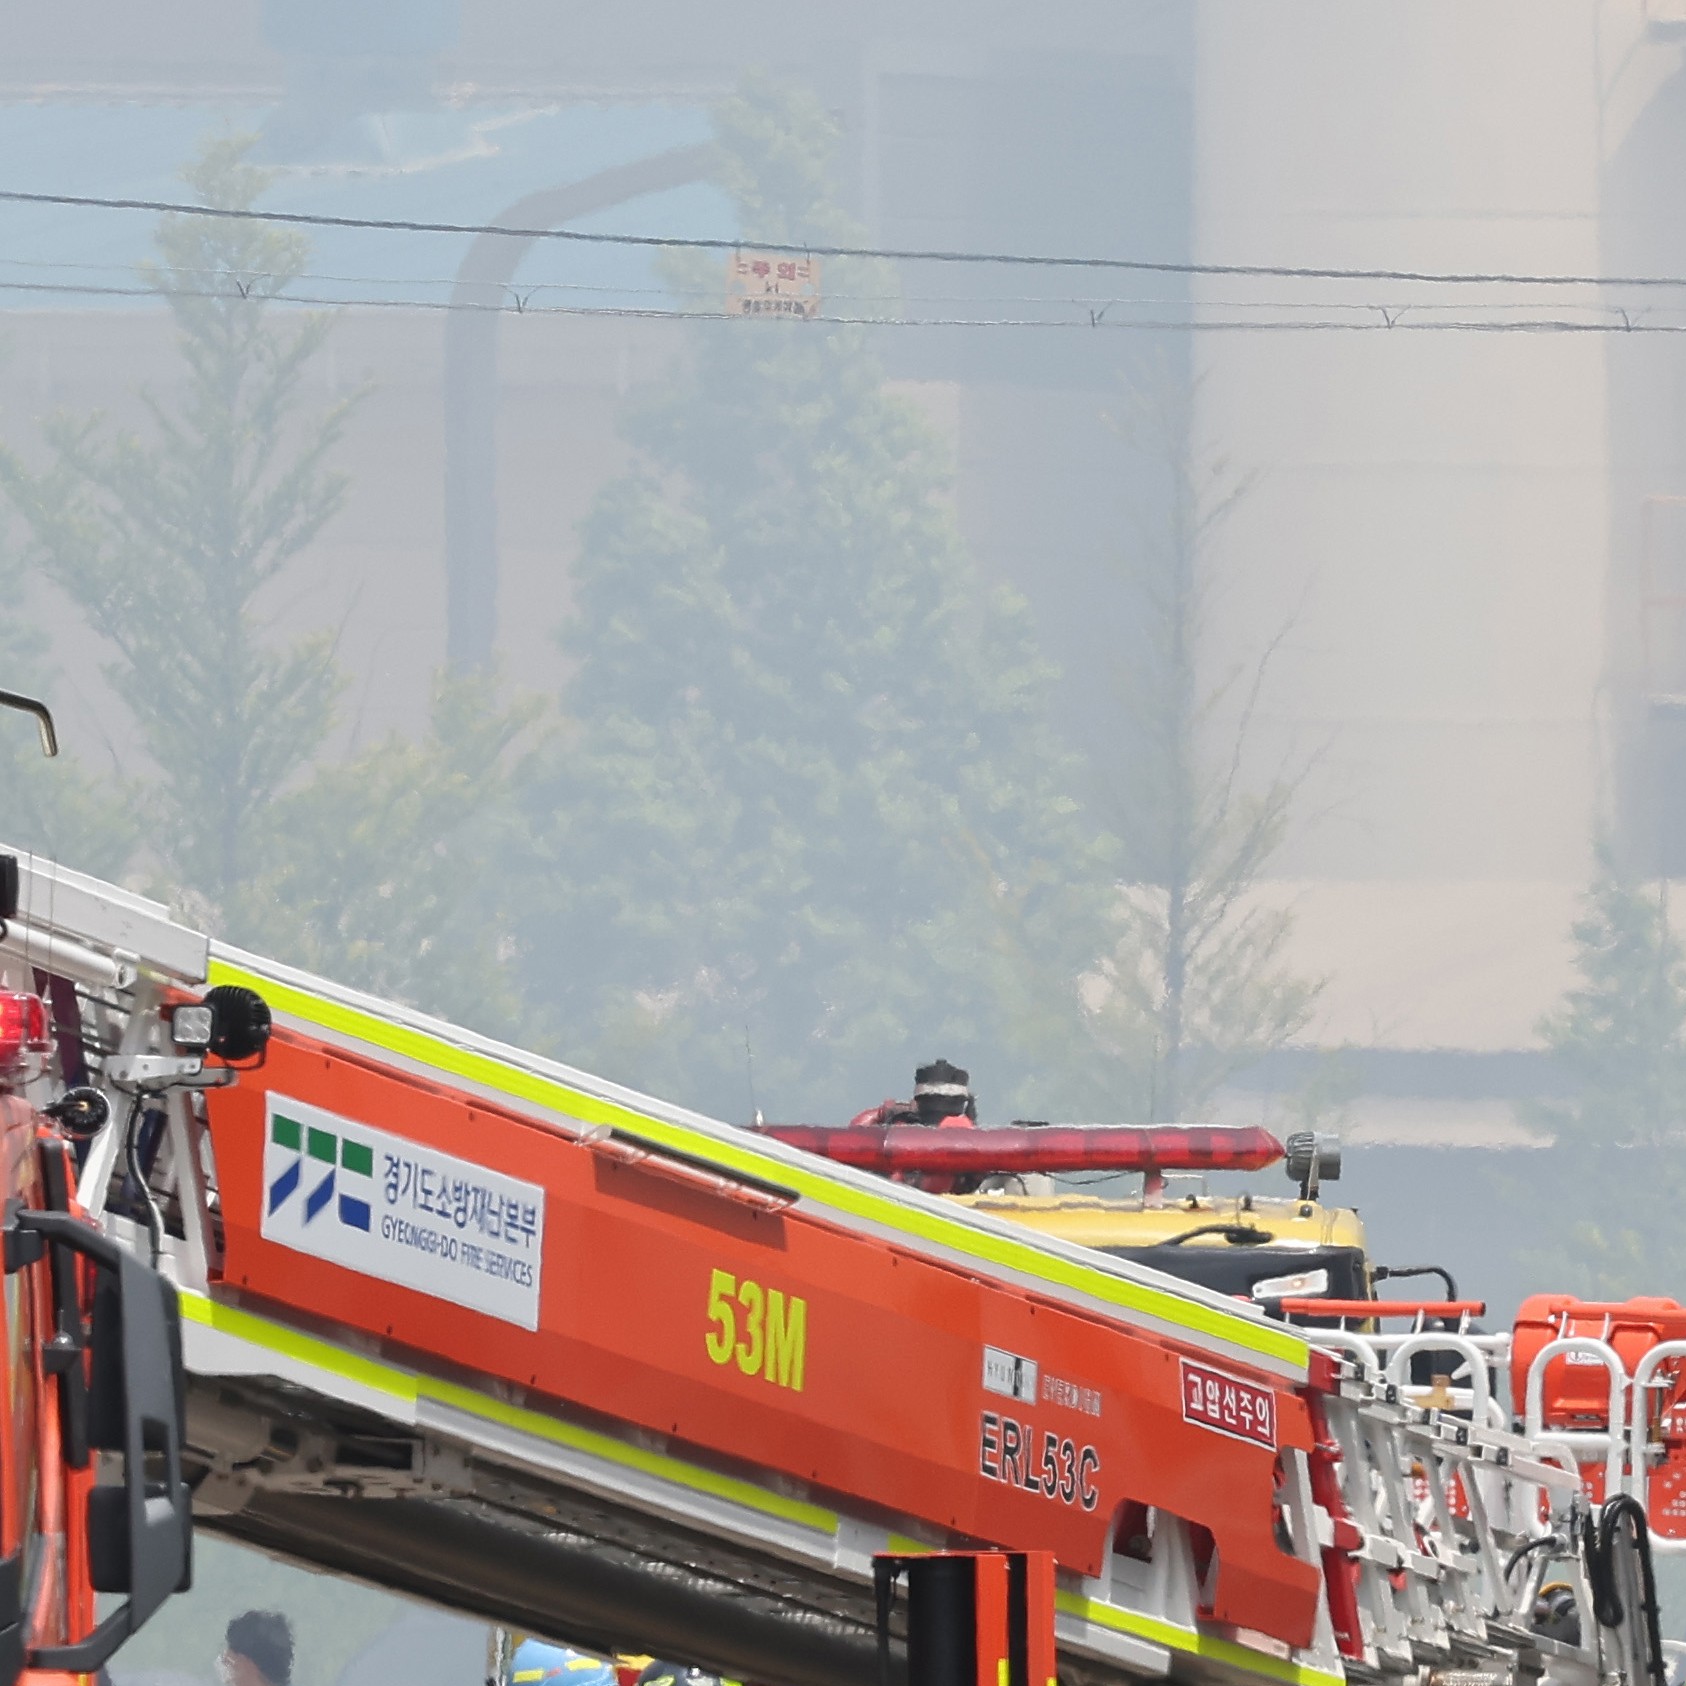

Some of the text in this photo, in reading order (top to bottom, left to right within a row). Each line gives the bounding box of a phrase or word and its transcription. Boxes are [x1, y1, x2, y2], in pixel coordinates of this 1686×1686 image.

[384, 1154, 537, 1249] 경기도소방재난본부
[381, 1214, 533, 1287] GYEONGGI-DO FIRE SERVICES
[705, 1268, 807, 1393] 53M
[1187, 1373, 1270, 1438] 고압선주의
[980, 1410, 1100, 1512] ERL53C
